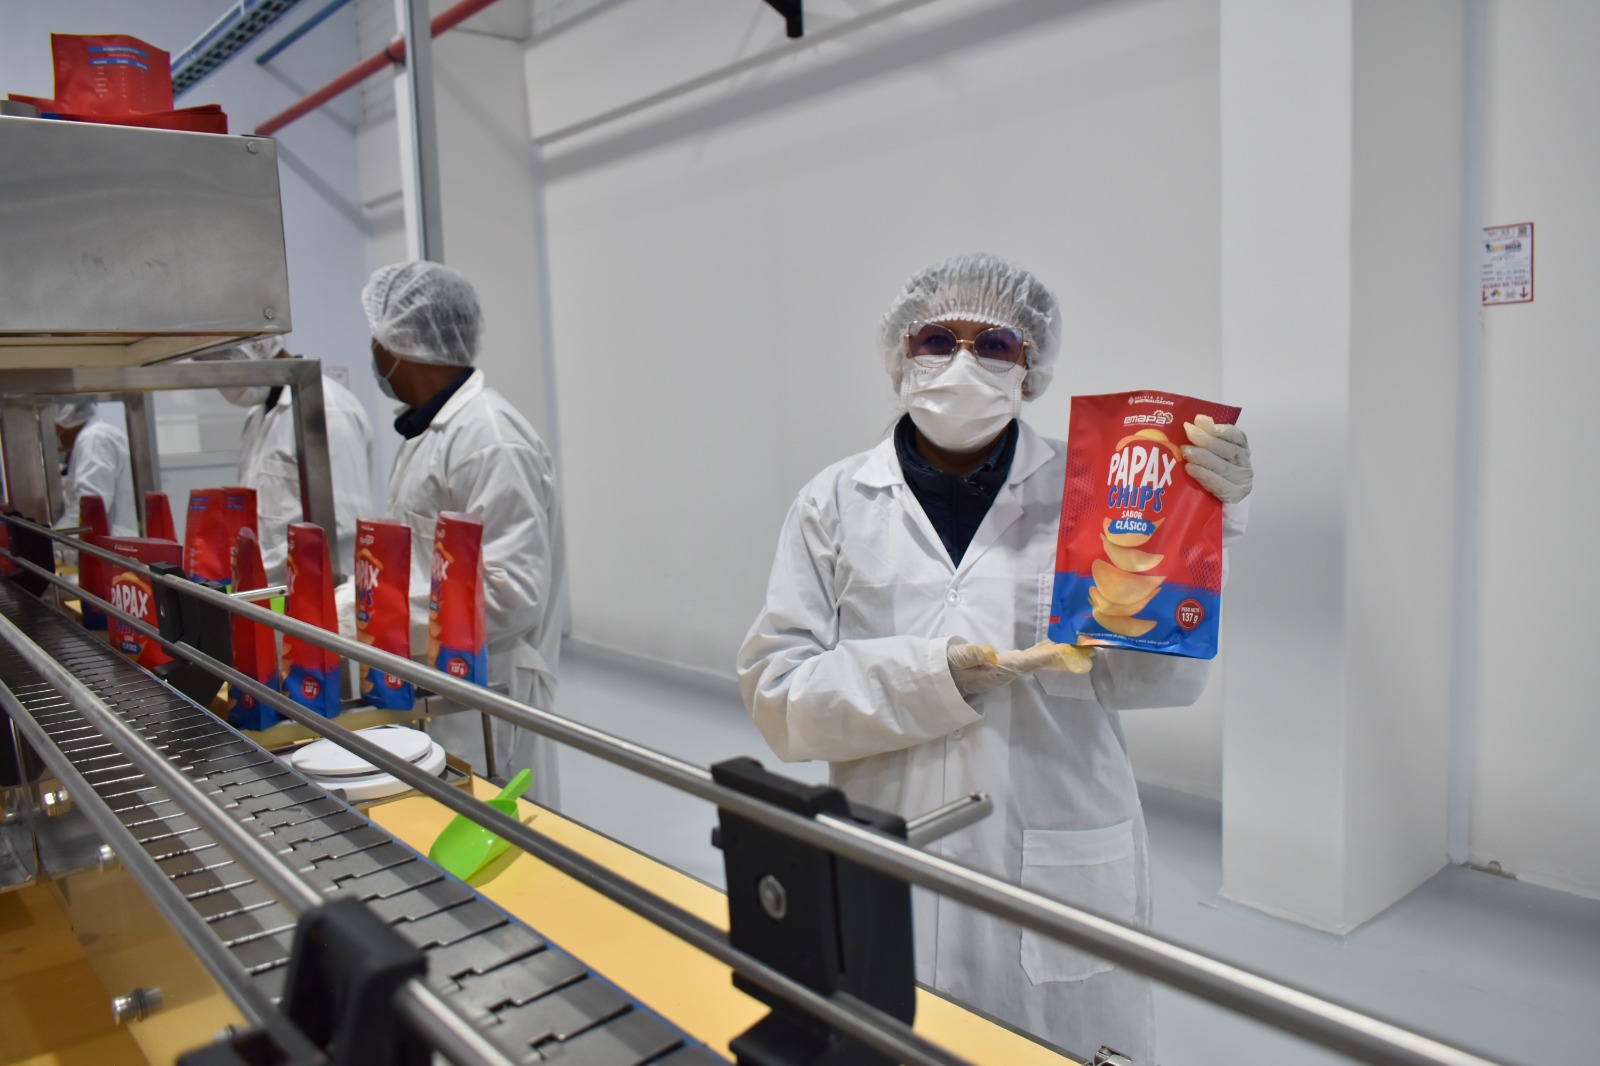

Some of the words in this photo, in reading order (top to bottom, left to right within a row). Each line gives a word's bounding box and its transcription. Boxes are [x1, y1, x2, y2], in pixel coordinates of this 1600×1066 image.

[1107, 445, 1177, 492] PAPAX
[1107, 485, 1165, 513] CHIPS
[1115, 517, 1148, 531] CLÁSICO
[1121, 510, 1143, 520] SABOR
[111, 584, 149, 618] PAPAX
[1181, 612, 1194, 622] 137
[1193, 615, 1199, 624] g
